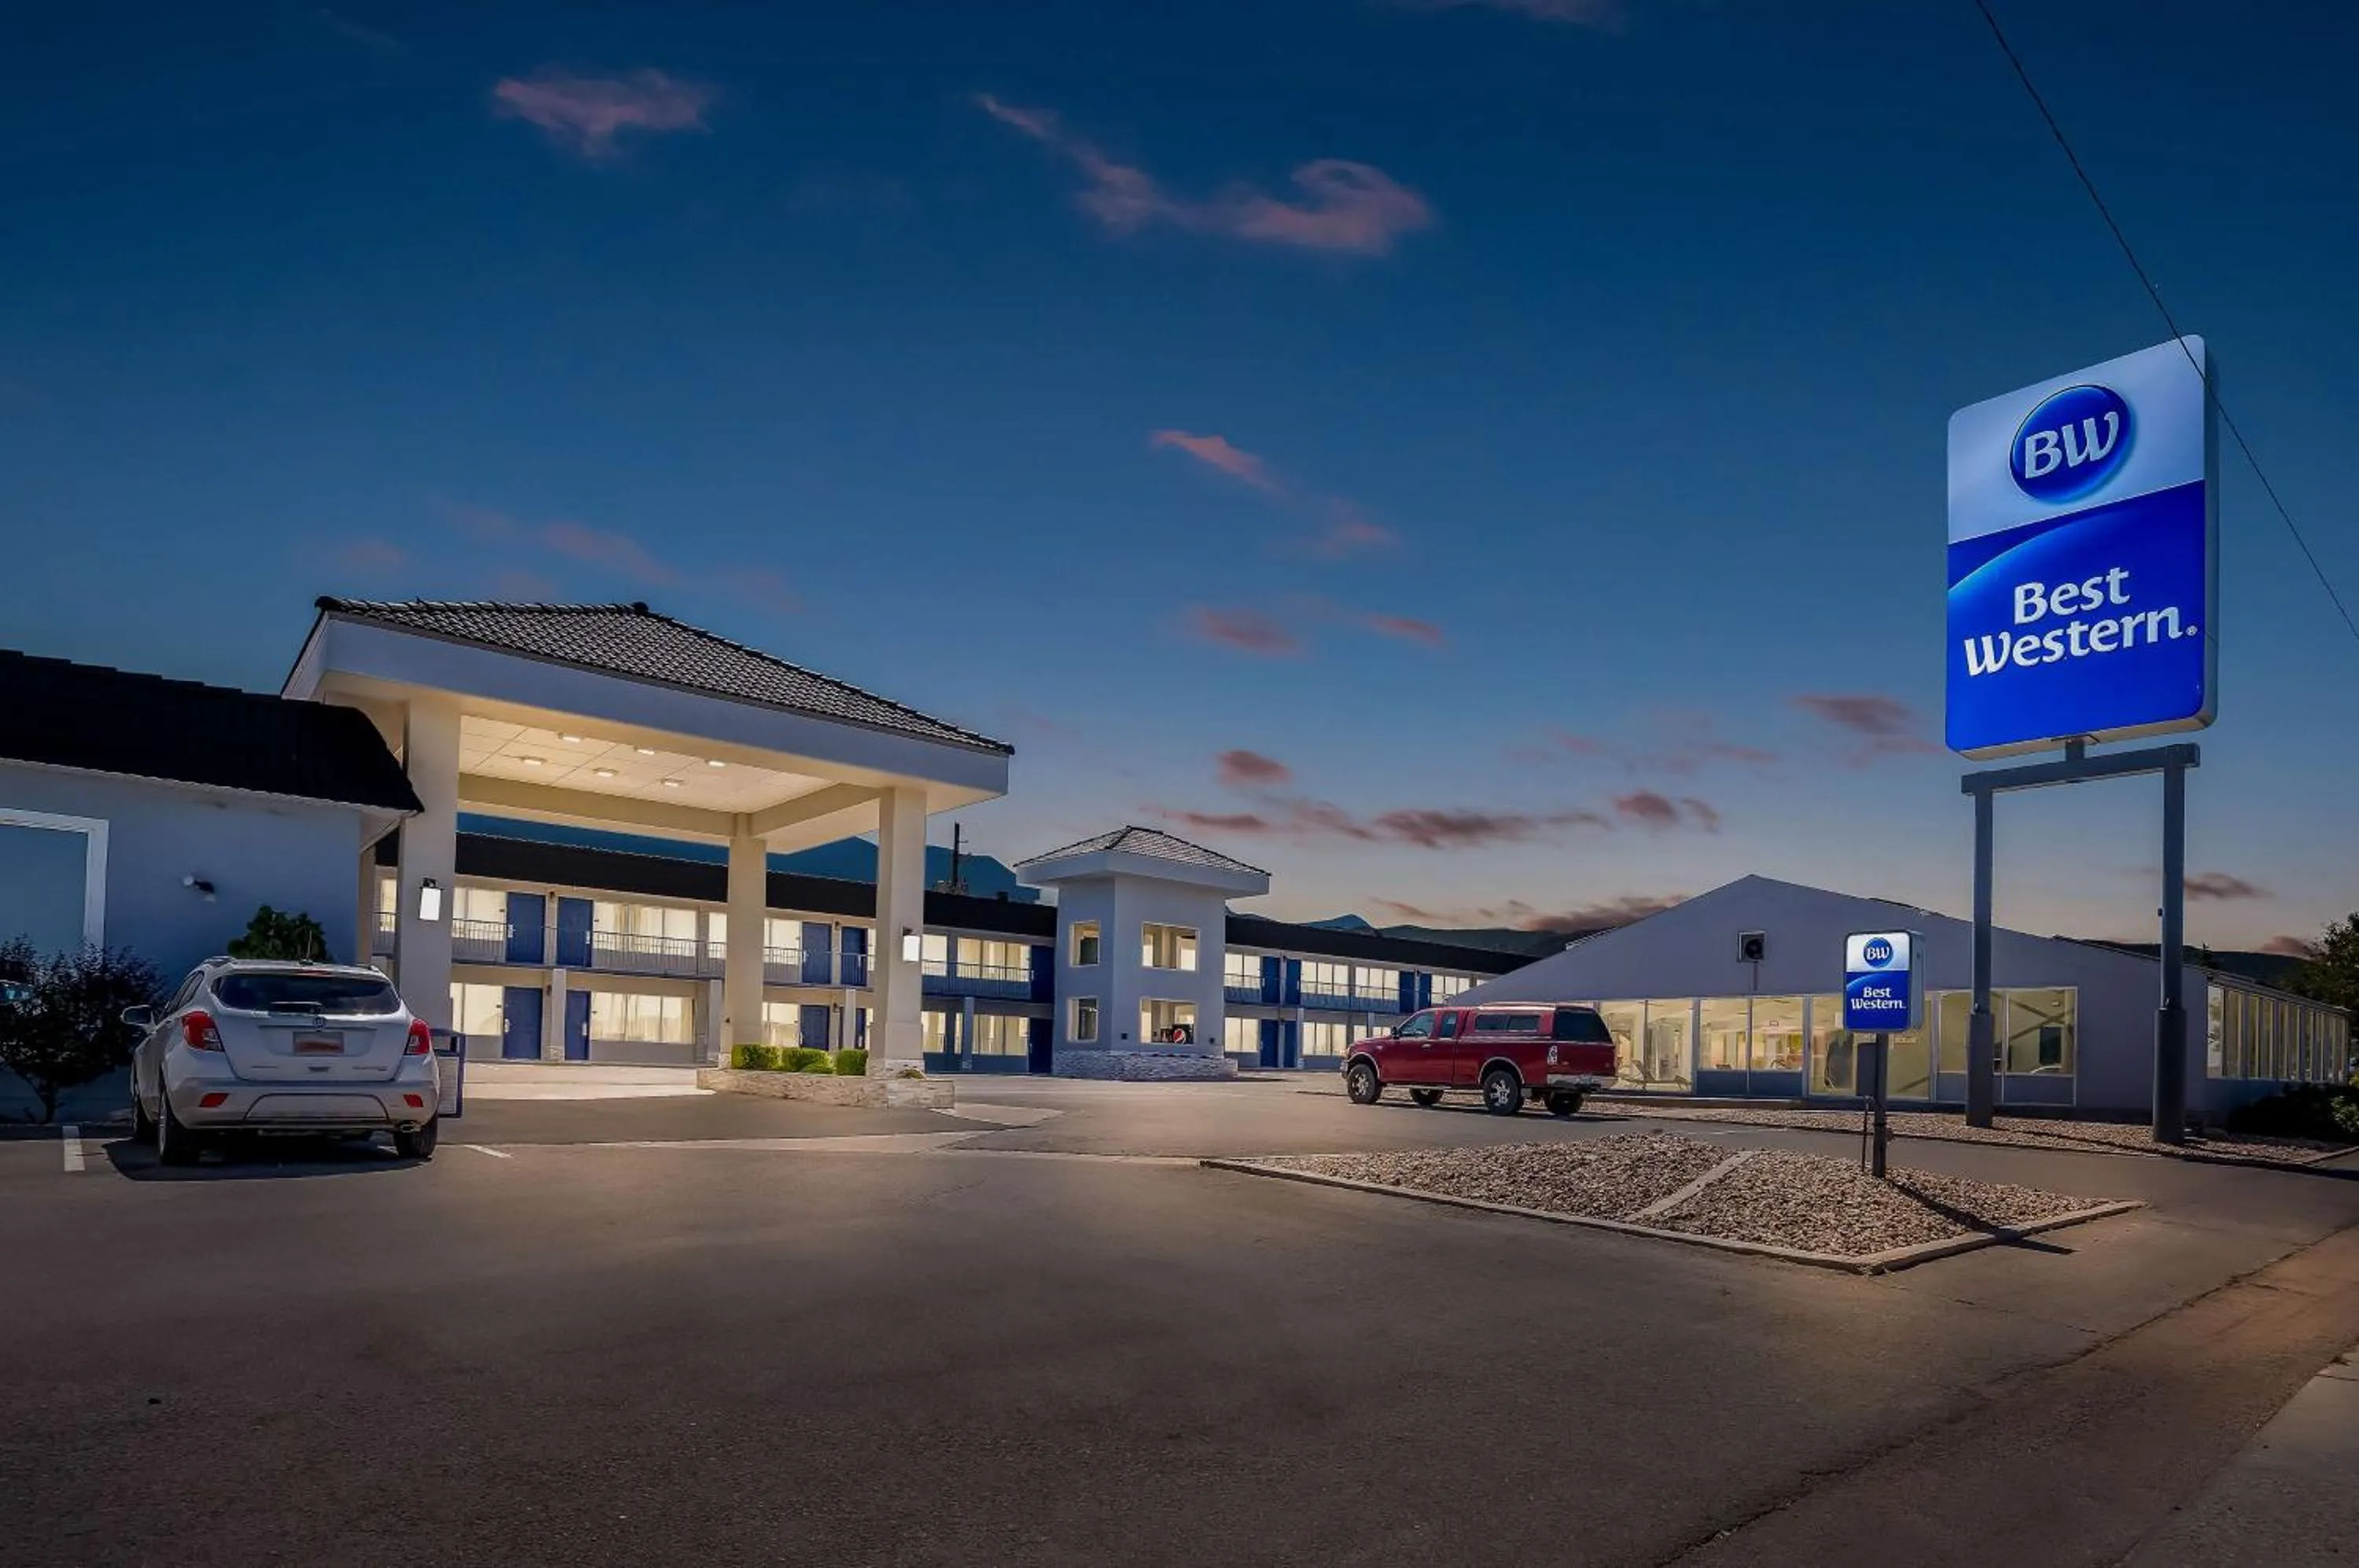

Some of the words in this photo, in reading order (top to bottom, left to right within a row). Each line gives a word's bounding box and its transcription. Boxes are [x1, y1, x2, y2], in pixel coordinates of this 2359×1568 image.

[2023, 410, 2120, 480] BW
[2013, 567, 2131, 624] Best
[1866, 946, 1890, 960] BW
[1863, 986, 1891, 998] Best
